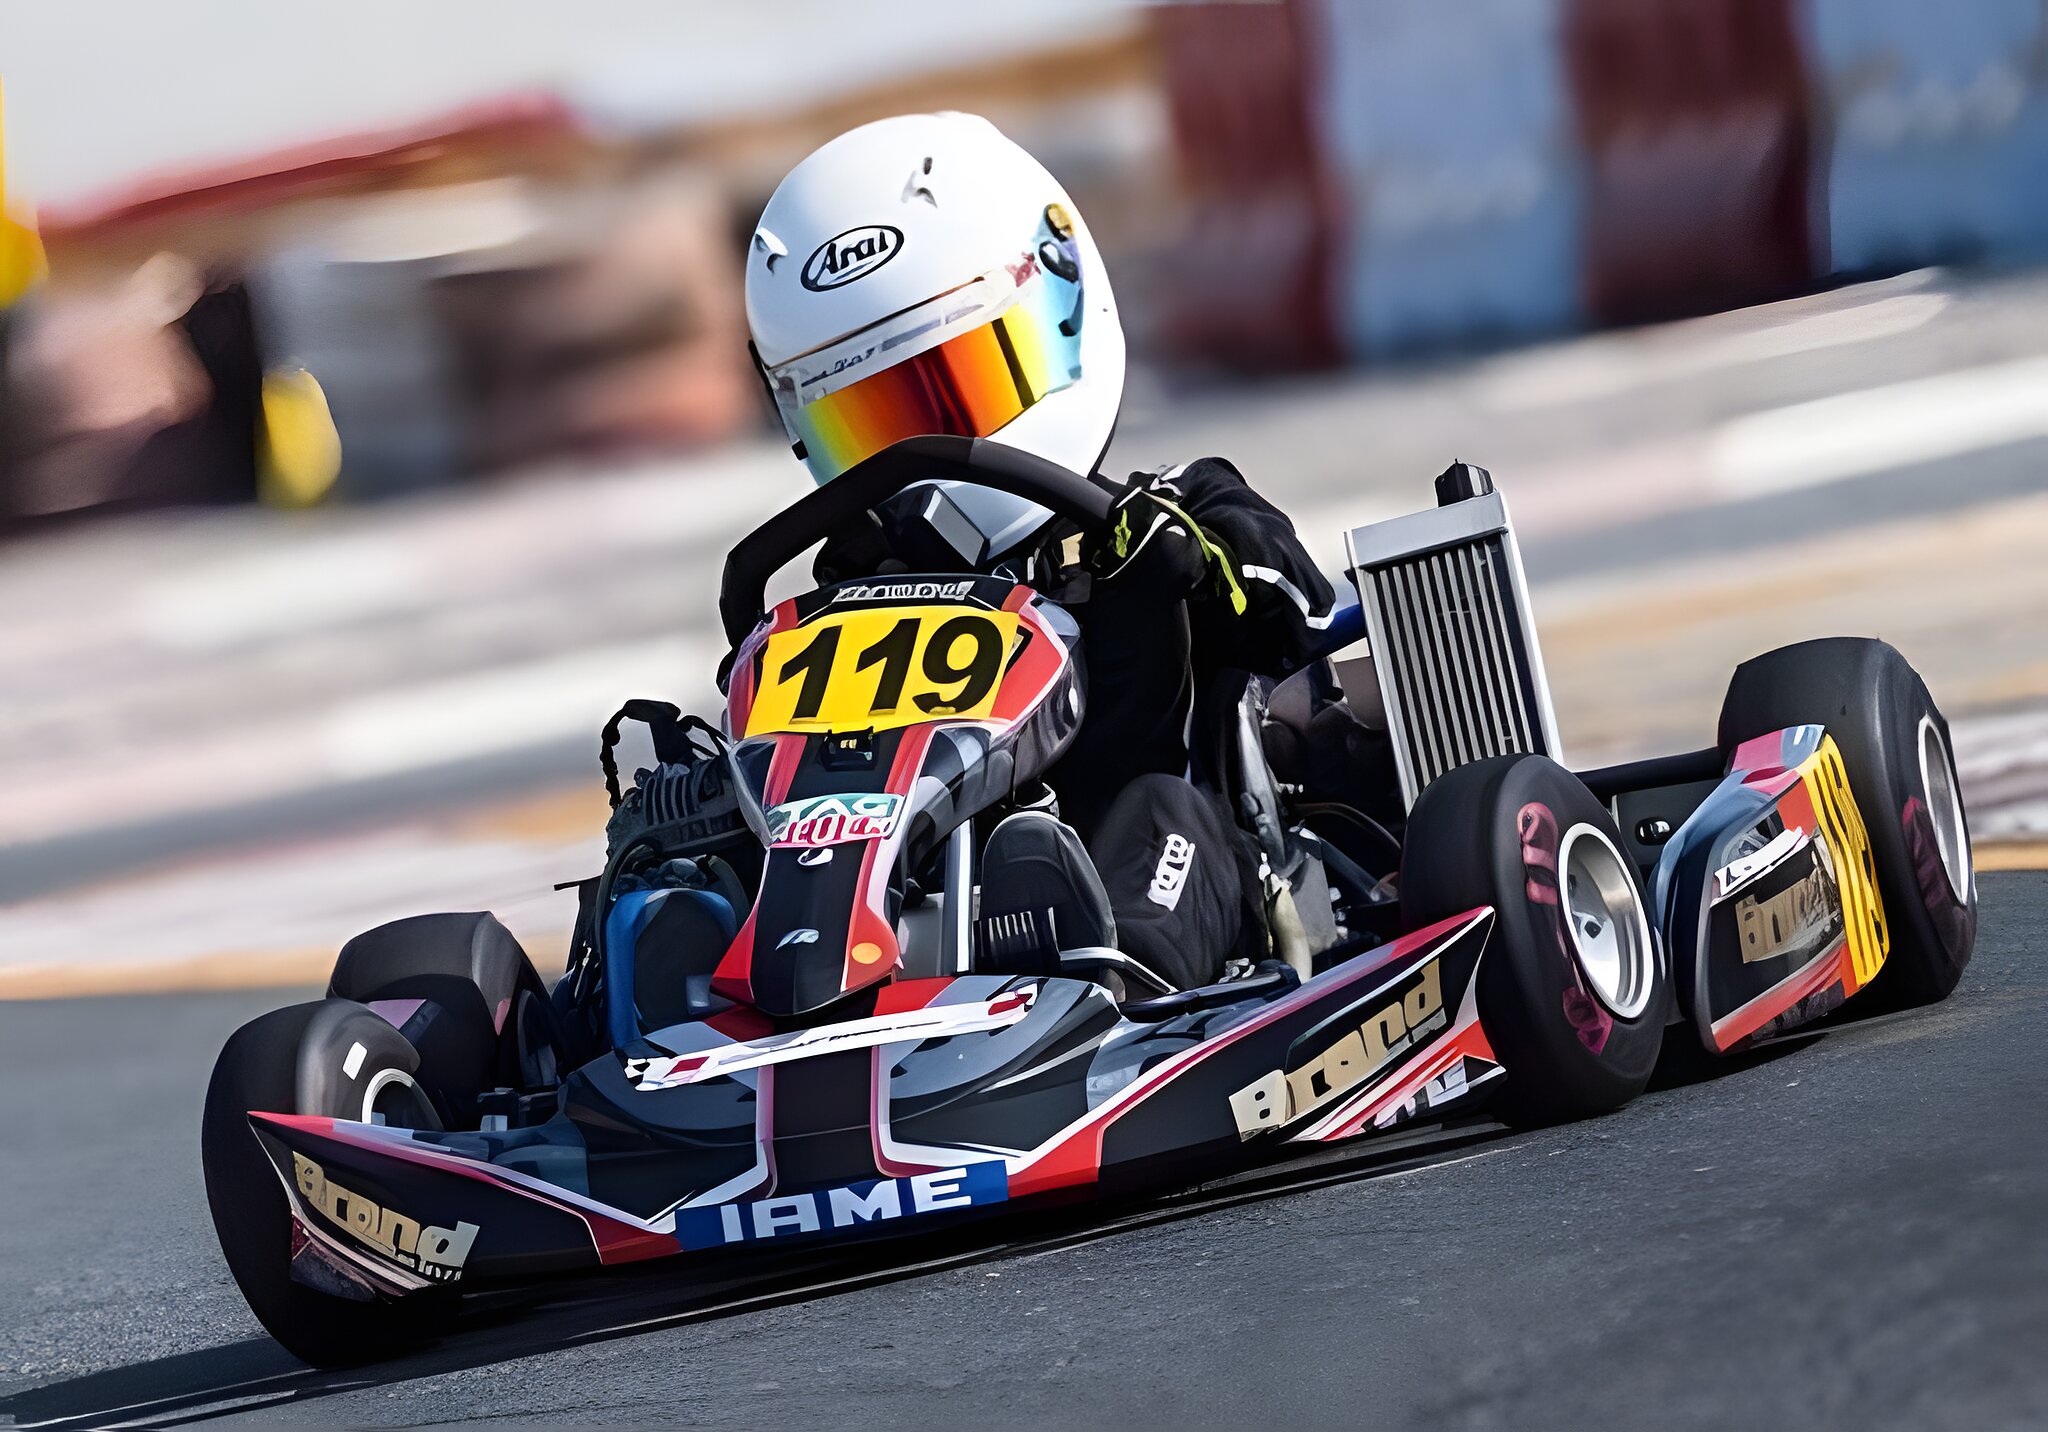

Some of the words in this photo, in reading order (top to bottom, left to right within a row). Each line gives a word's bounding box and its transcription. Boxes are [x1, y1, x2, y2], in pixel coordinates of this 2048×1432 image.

[810, 230, 890, 286] Arai
[778, 616, 1004, 720] 119
[721, 1167, 971, 1243] IAME
